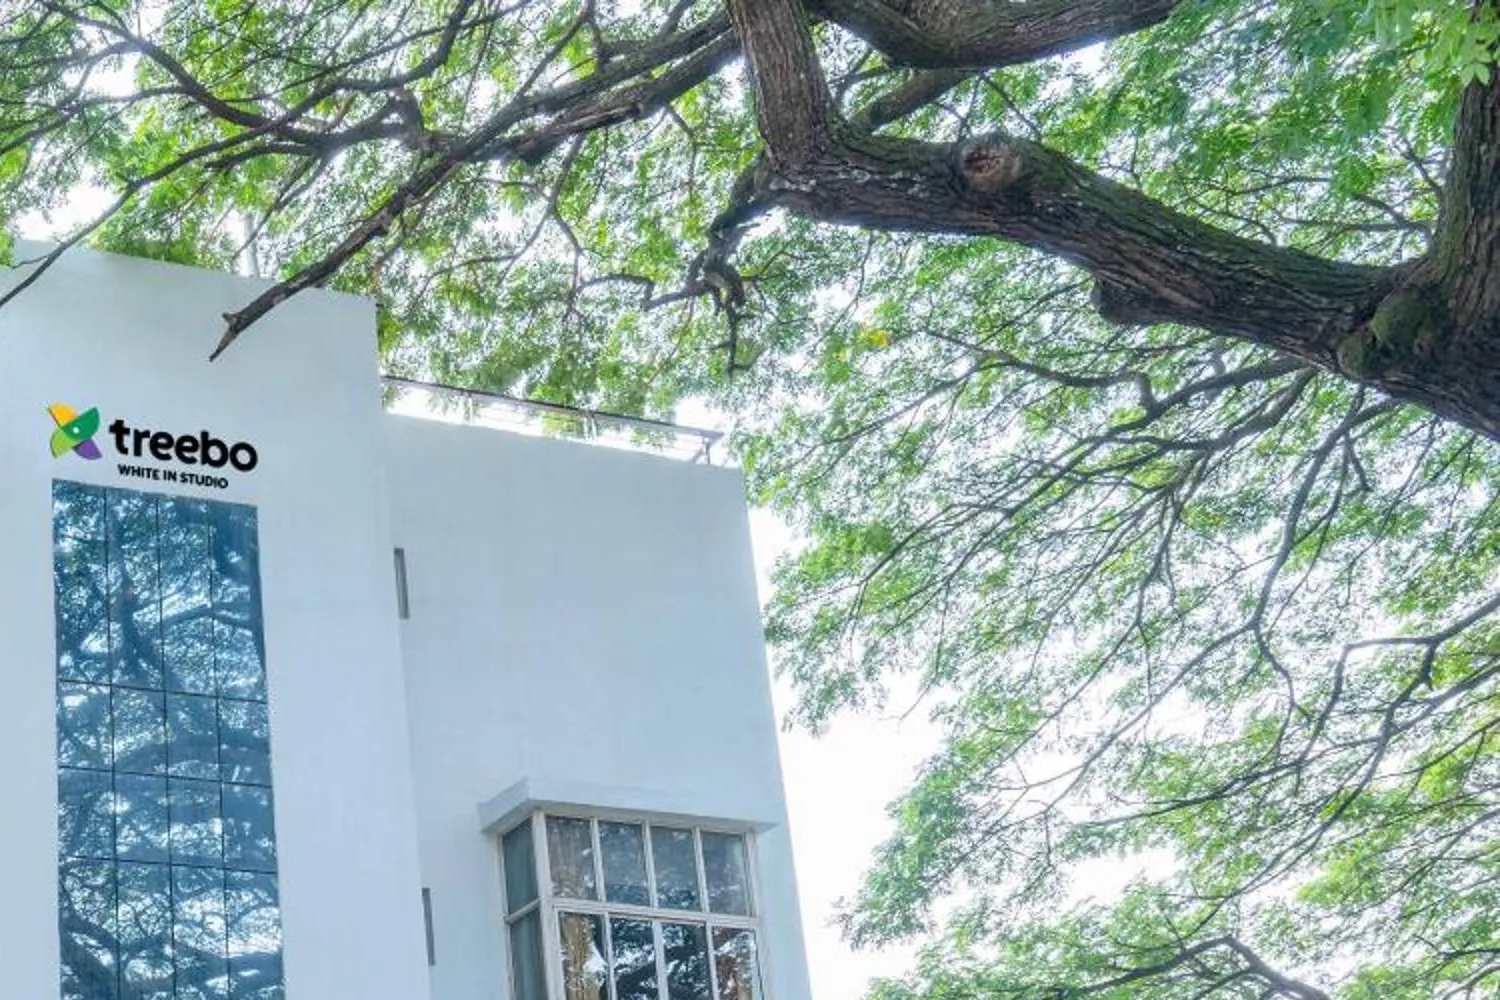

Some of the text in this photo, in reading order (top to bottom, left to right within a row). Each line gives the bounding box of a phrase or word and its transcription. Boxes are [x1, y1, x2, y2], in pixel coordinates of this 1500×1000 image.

[108, 418, 259, 473] treebo
[117, 463, 230, 490] WHITE IN STUDIO
